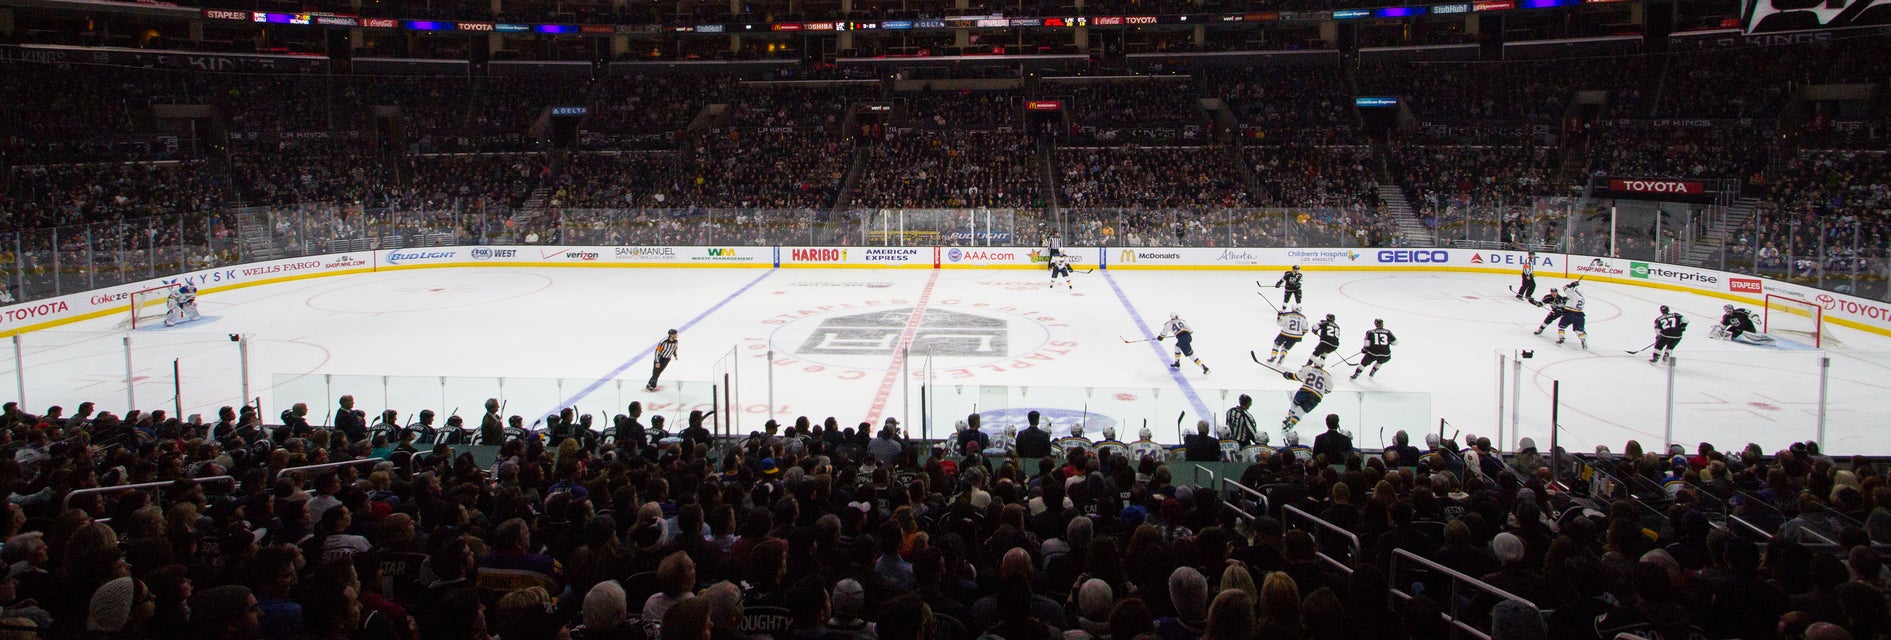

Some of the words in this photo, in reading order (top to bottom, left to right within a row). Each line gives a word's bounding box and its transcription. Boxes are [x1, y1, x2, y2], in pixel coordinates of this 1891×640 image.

[207, 11, 246, 20] STAPLES
[458, 23, 494, 31] TOYOTA
[1623, 180, 1688, 192] TOYOTA
[391, 252, 418, 261] BUD
[419, 251, 457, 260] LIGHT
[494, 249, 517, 258] WEST
[567, 252, 599, 260] verizon
[615, 248, 633, 256] SAN
[640, 248, 676, 256] MANUEL
[792, 249, 839, 261] HARIBO
[963, 250, 1015, 261] AAA.com
[1138, 251, 1181, 260] McDonald's
[1377, 250, 1449, 263] GEICO
[1490, 254, 1554, 267] DELTA
[243, 264, 281, 276] WELLS
[284, 261, 321, 272] FARGO
[1731, 280, 1761, 290] STAPLES
[91, 295, 115, 306] Coke
[5, 301, 69, 321] TOYOTA
[1838, 299, 1891, 322] TOYOT
[1289, 319, 1301, 331] 21
[1373, 333, 1389, 346] 13
[1305, 372, 1325, 390] 26
[740, 614, 797, 633] OUGHTY
